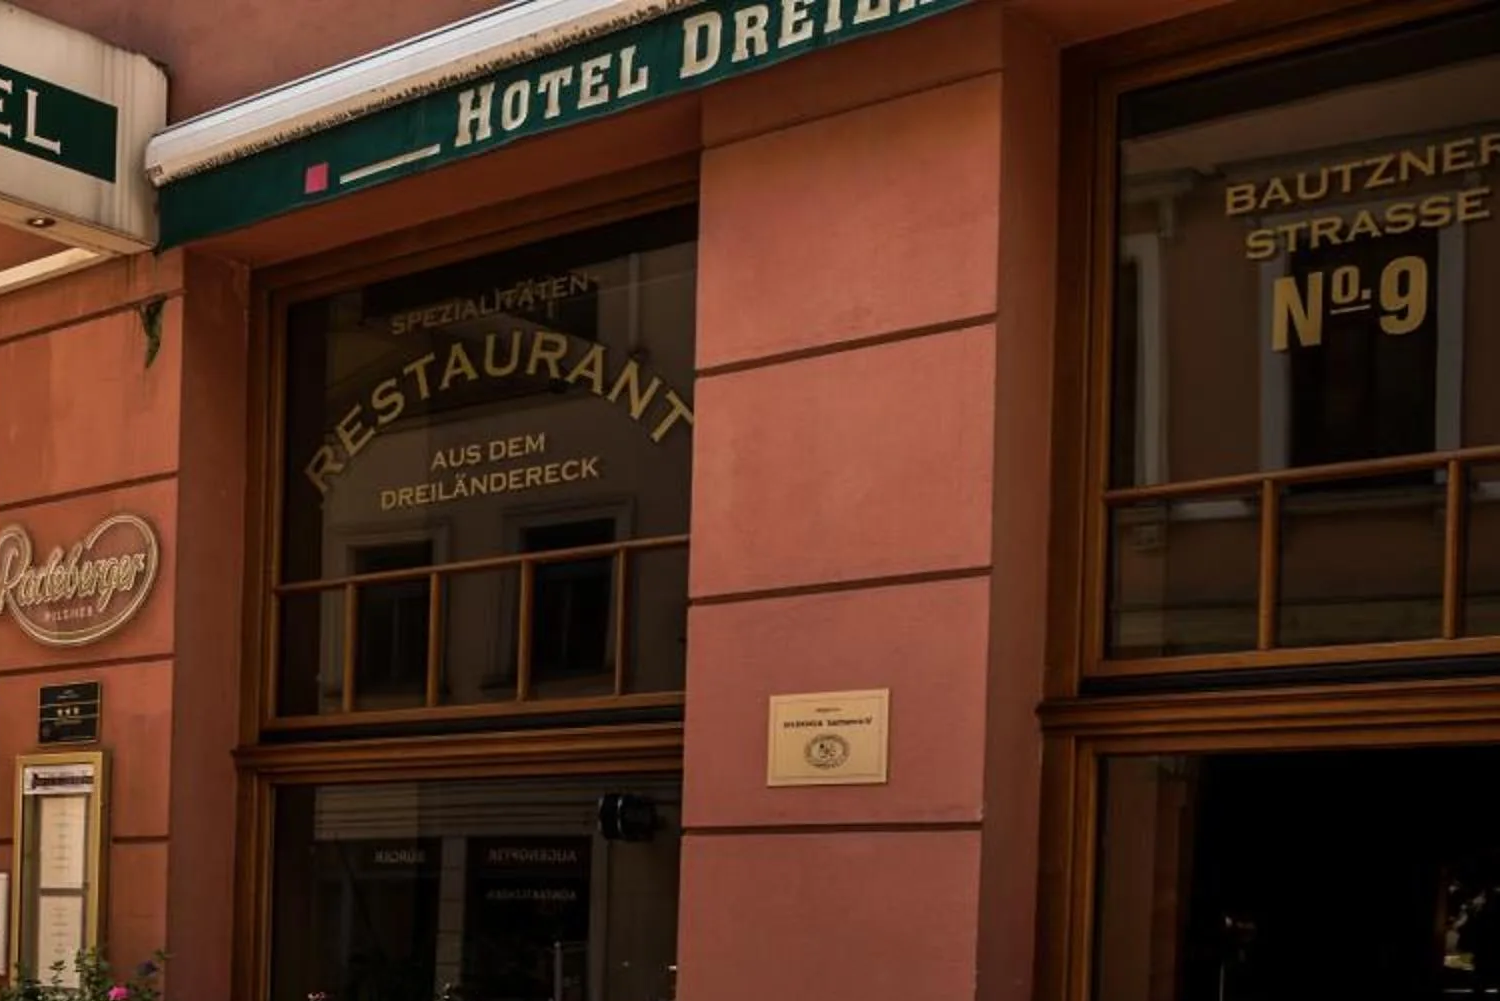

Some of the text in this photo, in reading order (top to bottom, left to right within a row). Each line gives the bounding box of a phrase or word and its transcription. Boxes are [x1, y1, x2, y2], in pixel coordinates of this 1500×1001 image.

[454, 0, 934, 148] HOTEL DREI
[1225, 132, 1500, 216] BAUTZNER
[1245, 186, 1491, 260] STRASSE
[1379, 255, 1429, 335] 9
[304, 329, 694, 494] RESTAURANT
[431, 432, 546, 471] AUS DEM
[380, 456, 599, 511] DREILÄNDERECK
